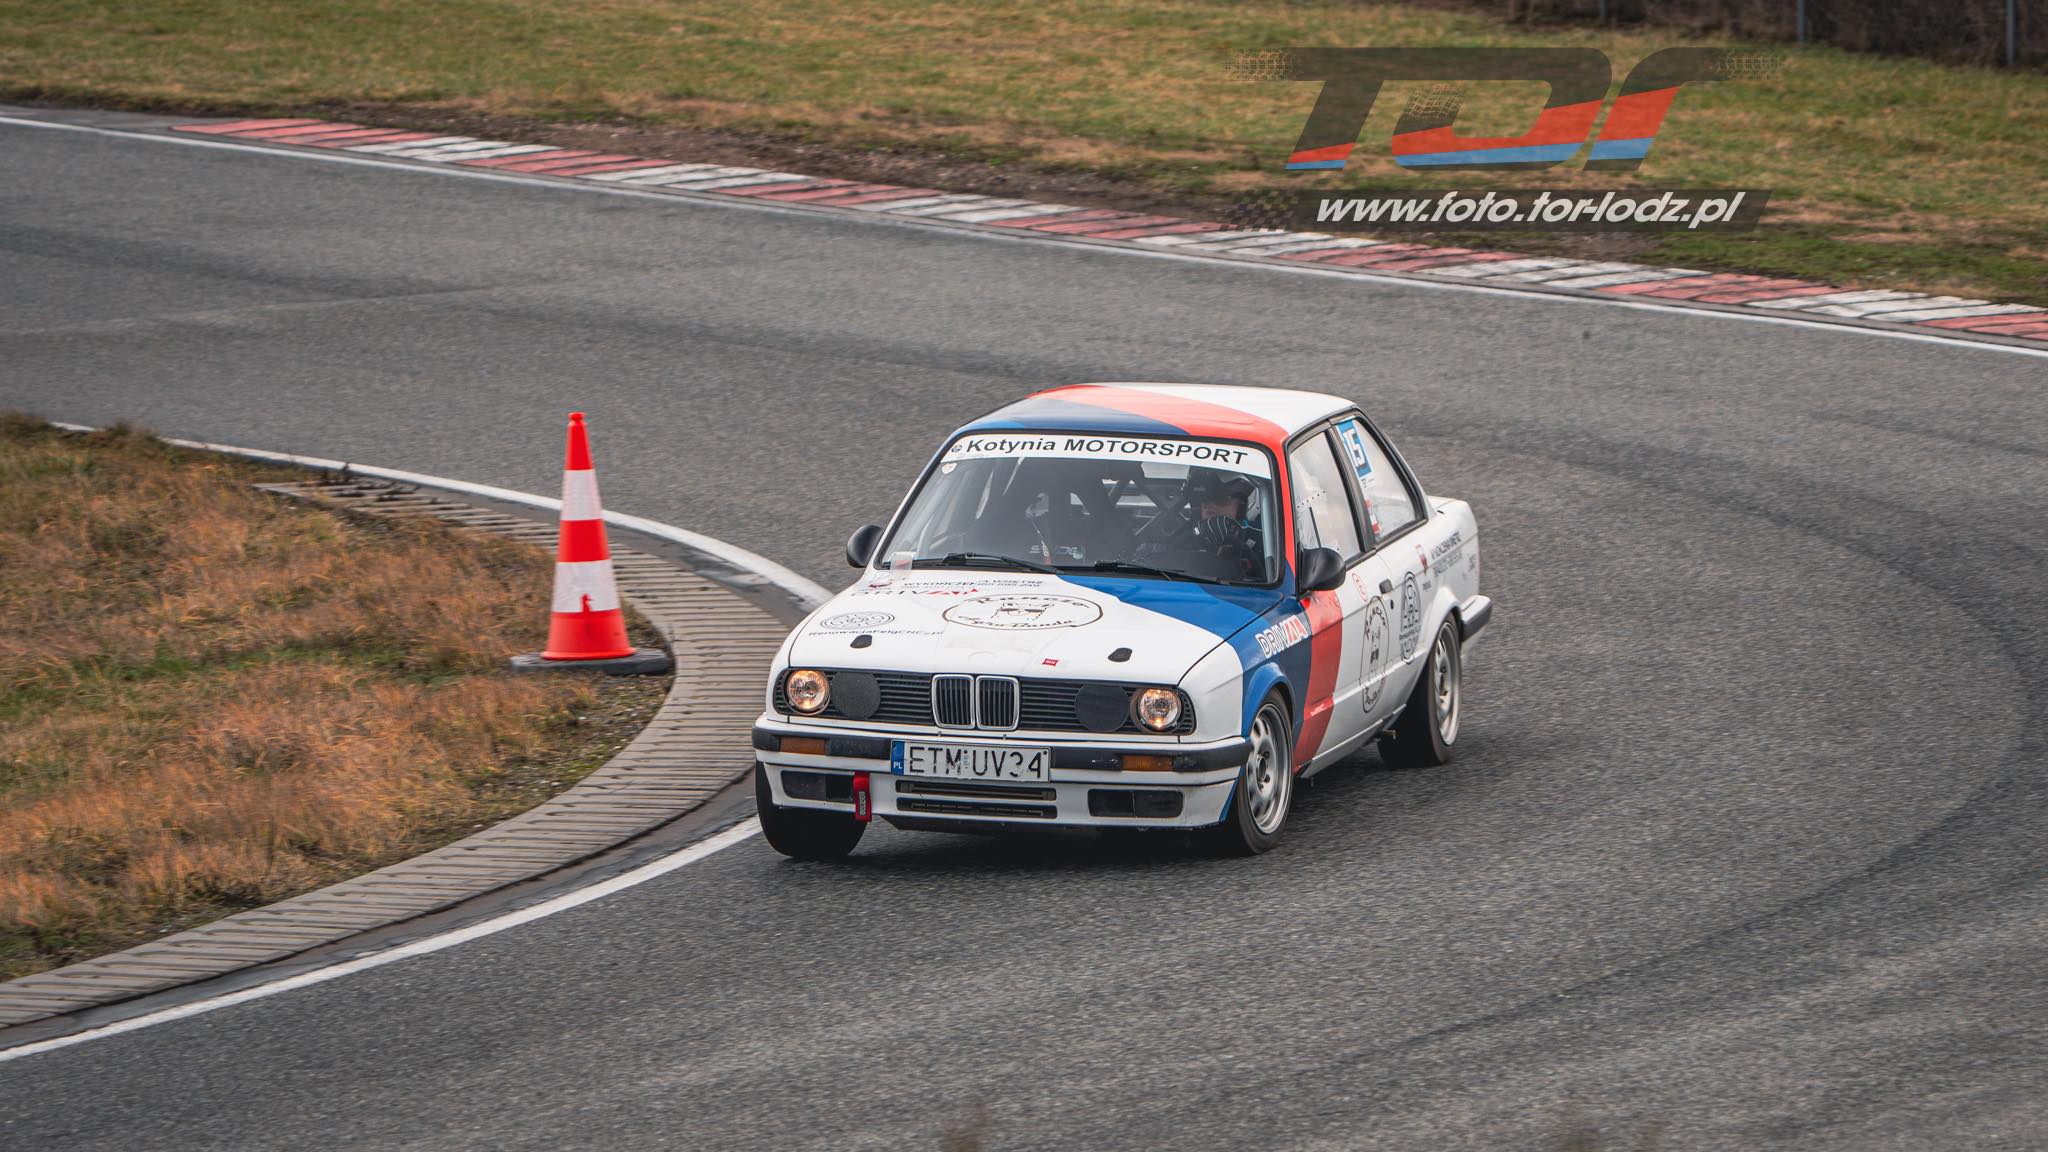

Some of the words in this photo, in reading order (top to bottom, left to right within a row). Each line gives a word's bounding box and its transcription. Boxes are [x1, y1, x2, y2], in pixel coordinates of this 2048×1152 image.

[966, 438, 1056, 454] Kotynia
[1063, 438, 1248, 465] MOTORSPORT
[893, 761, 903, 770] PL
[909, 746, 961, 775] ETM
[972, 750, 1042, 778] UV34
